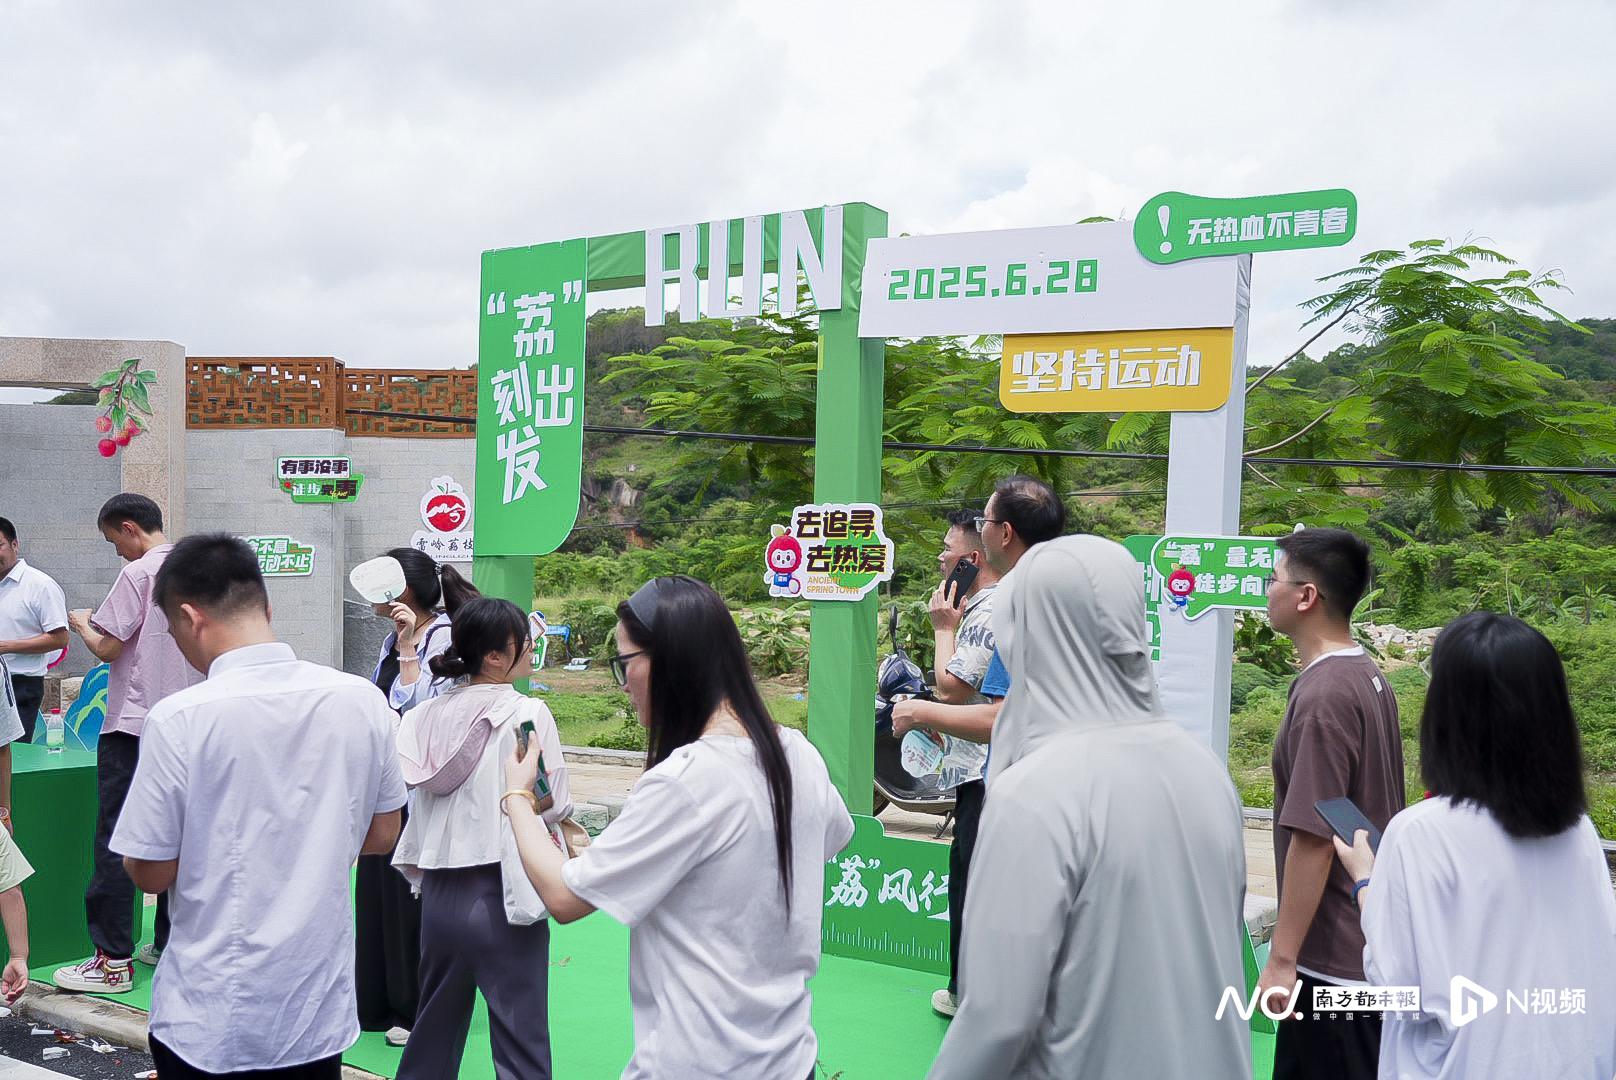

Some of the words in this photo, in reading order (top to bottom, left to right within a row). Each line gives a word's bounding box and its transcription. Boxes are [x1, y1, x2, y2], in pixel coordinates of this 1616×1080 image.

[1187, 206, 1348, 246] 无热血不青春
[644, 205, 844, 328] RUN
[887, 259, 1098, 300] 2025.6.28
[1009, 345, 1201, 394] 坚持运动
[281, 459, 349, 475] 有事没事
[796, 509, 877, 540] 去追寻
[806, 544, 888, 575] 去热爱
[1165, 541, 1281, 569] “荔”量无
[806, 585, 834, 594] SPRING
[1194, 573, 1270, 597] 徒步向
